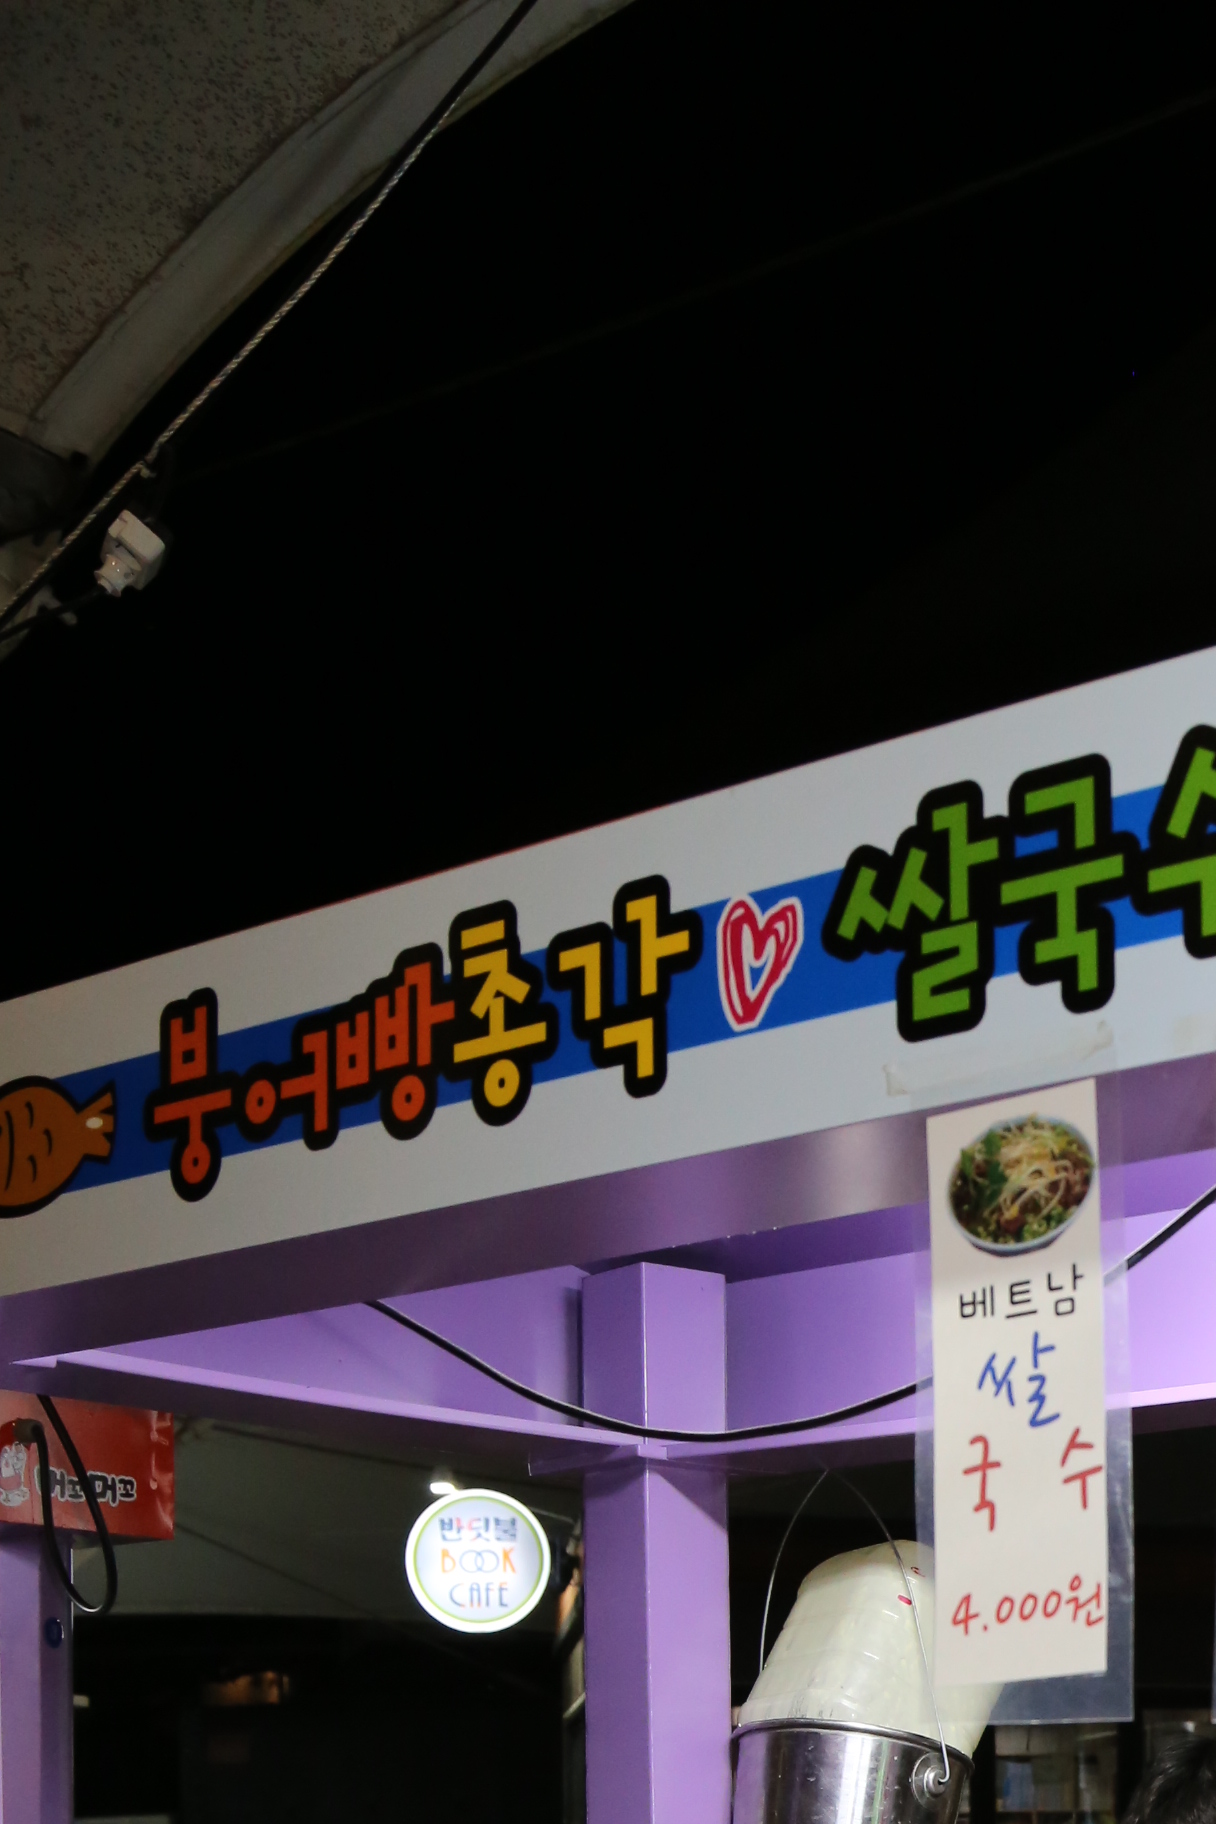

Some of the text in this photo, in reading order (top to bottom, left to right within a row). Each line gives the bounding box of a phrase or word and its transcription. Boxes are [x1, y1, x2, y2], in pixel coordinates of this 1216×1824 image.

[959, 1262, 1086, 1320] 베트남
[977, 1331, 1060, 1428] 쌀
[441, 1547, 517, 1574] BOOK
[449, 1581, 509, 1608] CAFE
